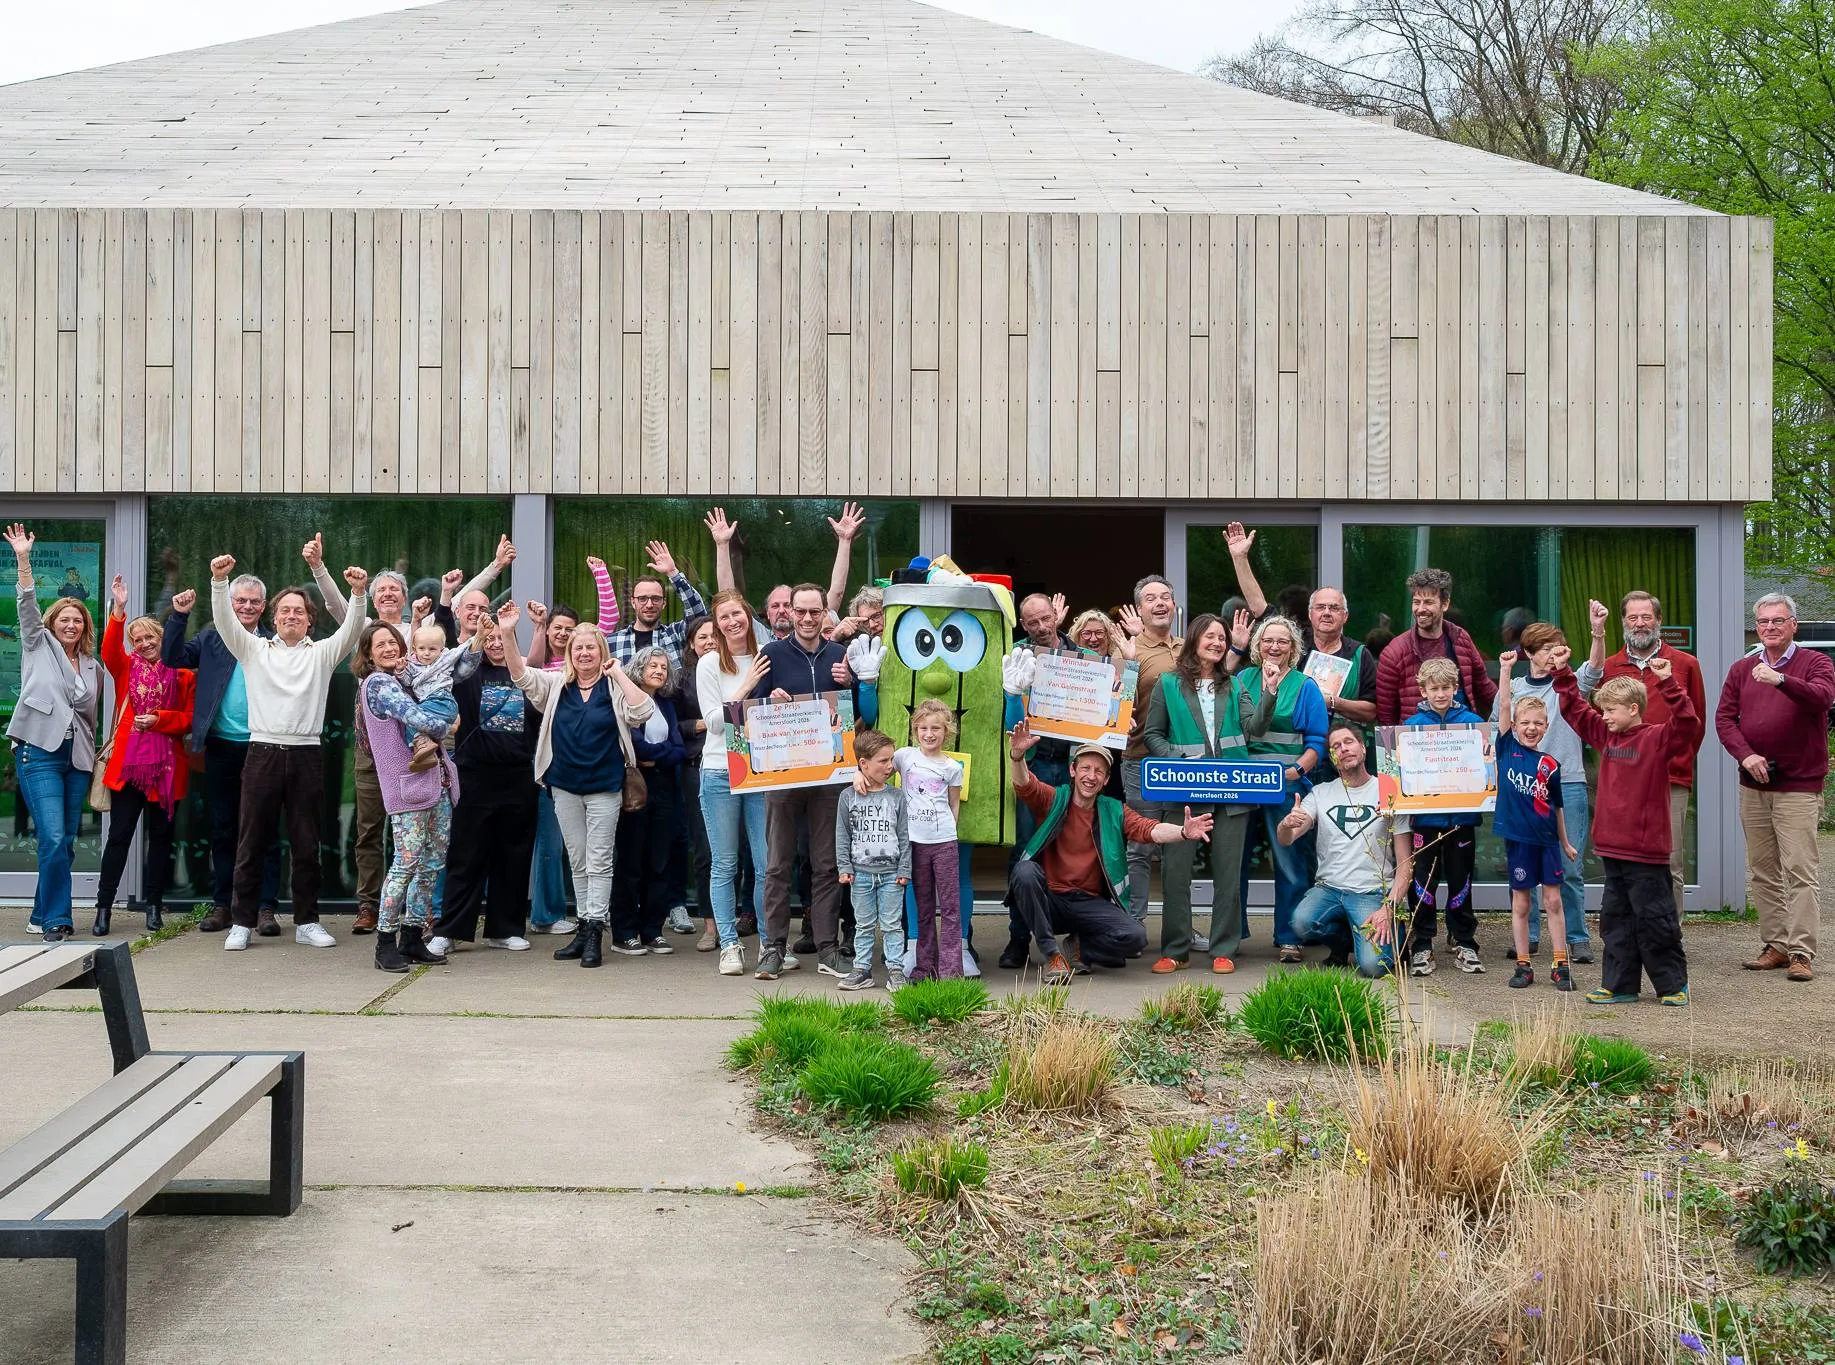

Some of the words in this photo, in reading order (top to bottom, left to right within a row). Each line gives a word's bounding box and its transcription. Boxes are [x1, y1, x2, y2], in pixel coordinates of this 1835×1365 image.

[1062, 658, 1090, 668] Winnaar
[1048, 680, 1061, 688] Van
[773, 704, 781, 712] 2e
[784, 703, 801, 711] Prijs
[1436, 731, 1453, 740] Prijs
[1150, 767, 1228, 783] Schoonste
[1232, 769, 1277, 785] Straat
[1507, 768, 1549, 796] QATAR
[860, 805, 882, 817] HEY
